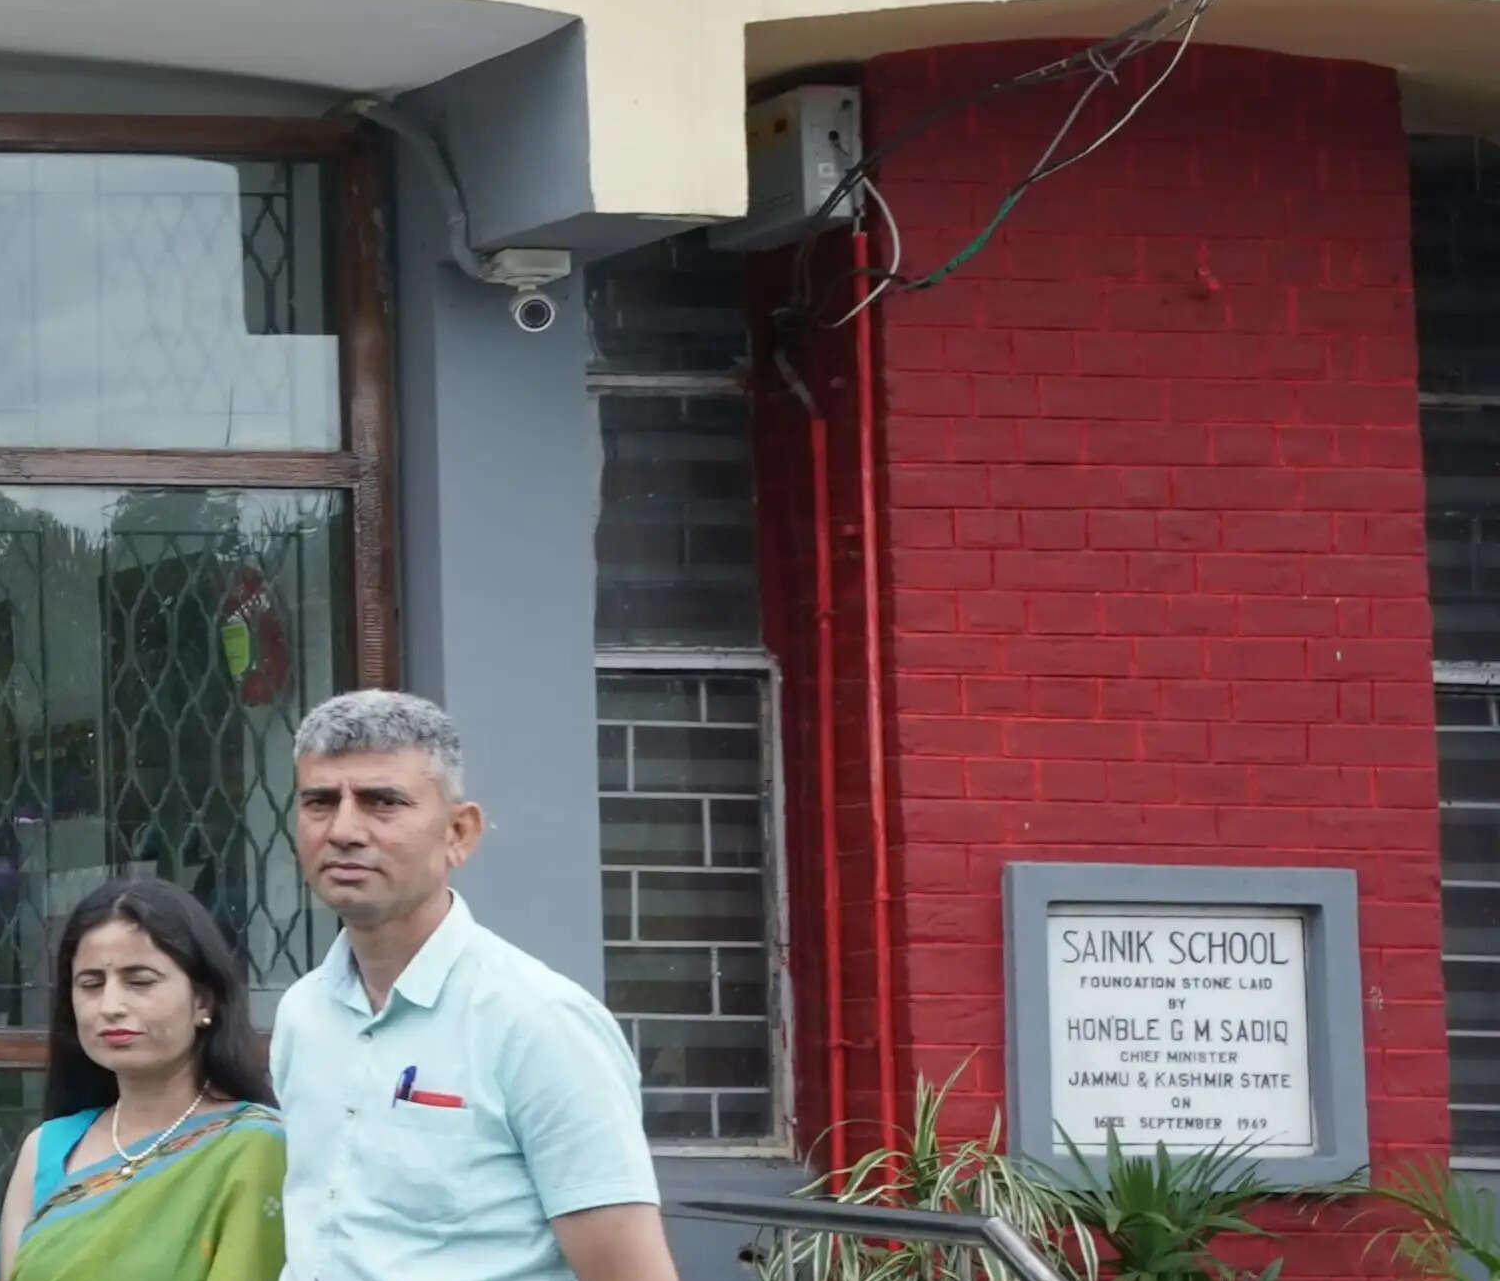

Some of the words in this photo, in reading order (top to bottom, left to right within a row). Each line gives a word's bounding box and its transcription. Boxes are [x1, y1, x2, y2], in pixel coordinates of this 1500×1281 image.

[1062, 929, 1154, 964] SAINIK
[1168, 930, 1289, 965] SCHOOL
[1080, 976, 1176, 989] FOUNDATION
[1182, 976, 1231, 989] STONE
[1239, 977, 1273, 990] LAID
[1168, 997, 1186, 1010] BY
[1220, 1019, 1289, 1046] SADIQ
[1120, 1050, 1161, 1063] CHIEF
[1167, 1050, 1238, 1064] MINISTER
[1068, 1071, 1130, 1087] JAMMU
[1137, 1071, 1148, 1089] &
[1155, 1071, 1234, 1088] KASHMIR
[1240, 1072, 1292, 1089] STATE
[1171, 1096, 1191, 1109] ON
[1140, 1116, 1223, 1130] SEPTEMBER
